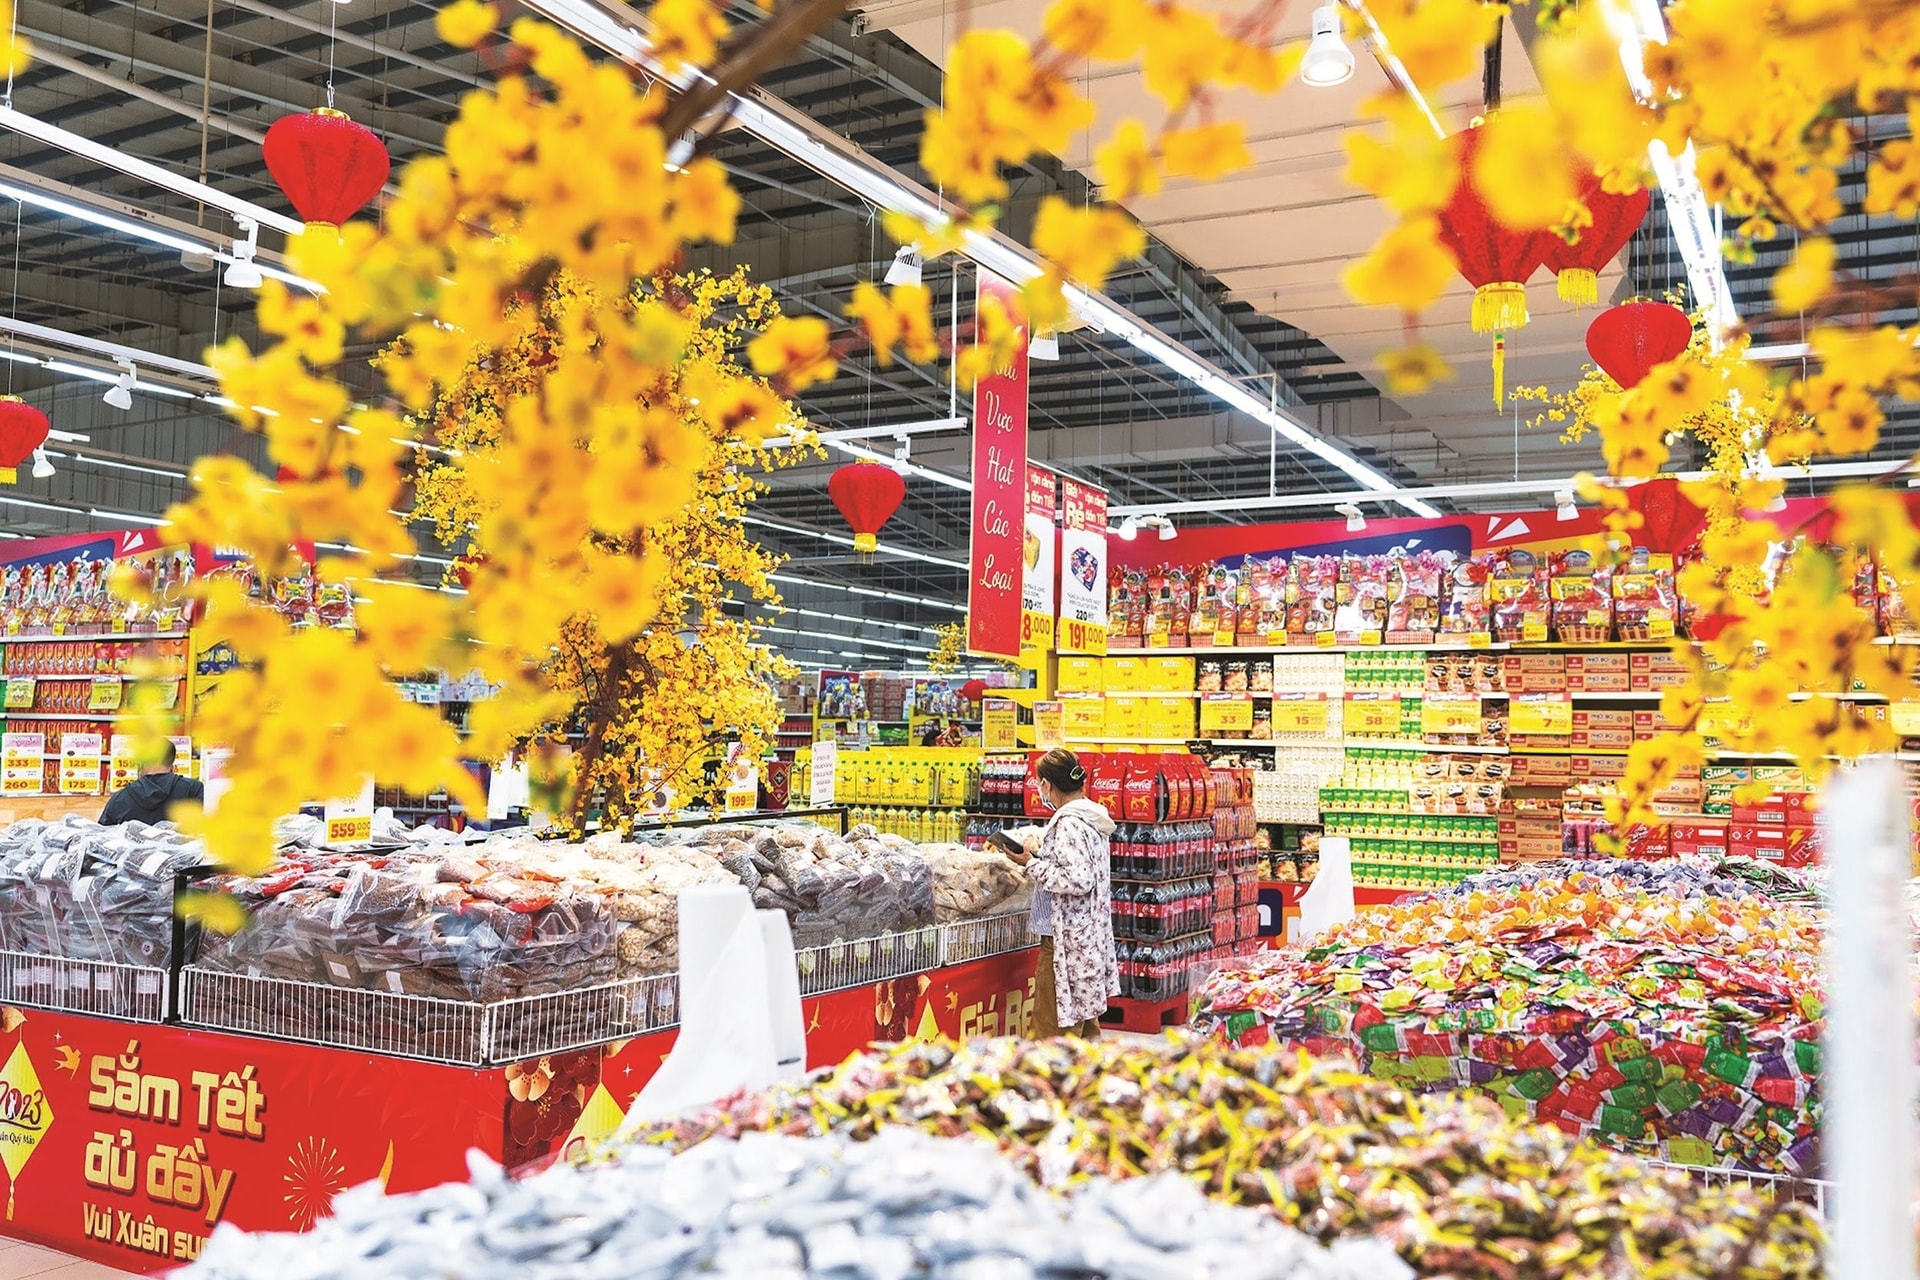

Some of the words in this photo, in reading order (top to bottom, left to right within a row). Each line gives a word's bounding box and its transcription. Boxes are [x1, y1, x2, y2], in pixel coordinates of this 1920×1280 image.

[986, 390, 1014, 434] Vực
[988, 446, 1014, 492] Hạt
[984, 500, 1010, 538] Các
[980, 554, 1014, 598] Loại
[1075, 713, 1089, 721] 75
[1221, 716, 1236, 724] 33
[1365, 717, 1382, 725] 58
[1447, 718, 1462, 726] 91
[1543, 719, 1552, 727] 7
[732, 795, 746, 807] 199
[331, 823, 356, 838] 559
[88, 1039, 180, 1122] Sắm
[191, 1064, 266, 1137] Tết
[84, 1128, 137, 1192] đủ
[146, 1137, 234, 1222] đầy
[82, 1201, 112, 1240] Vui
[116, 1214, 169, 1255] Xuân
